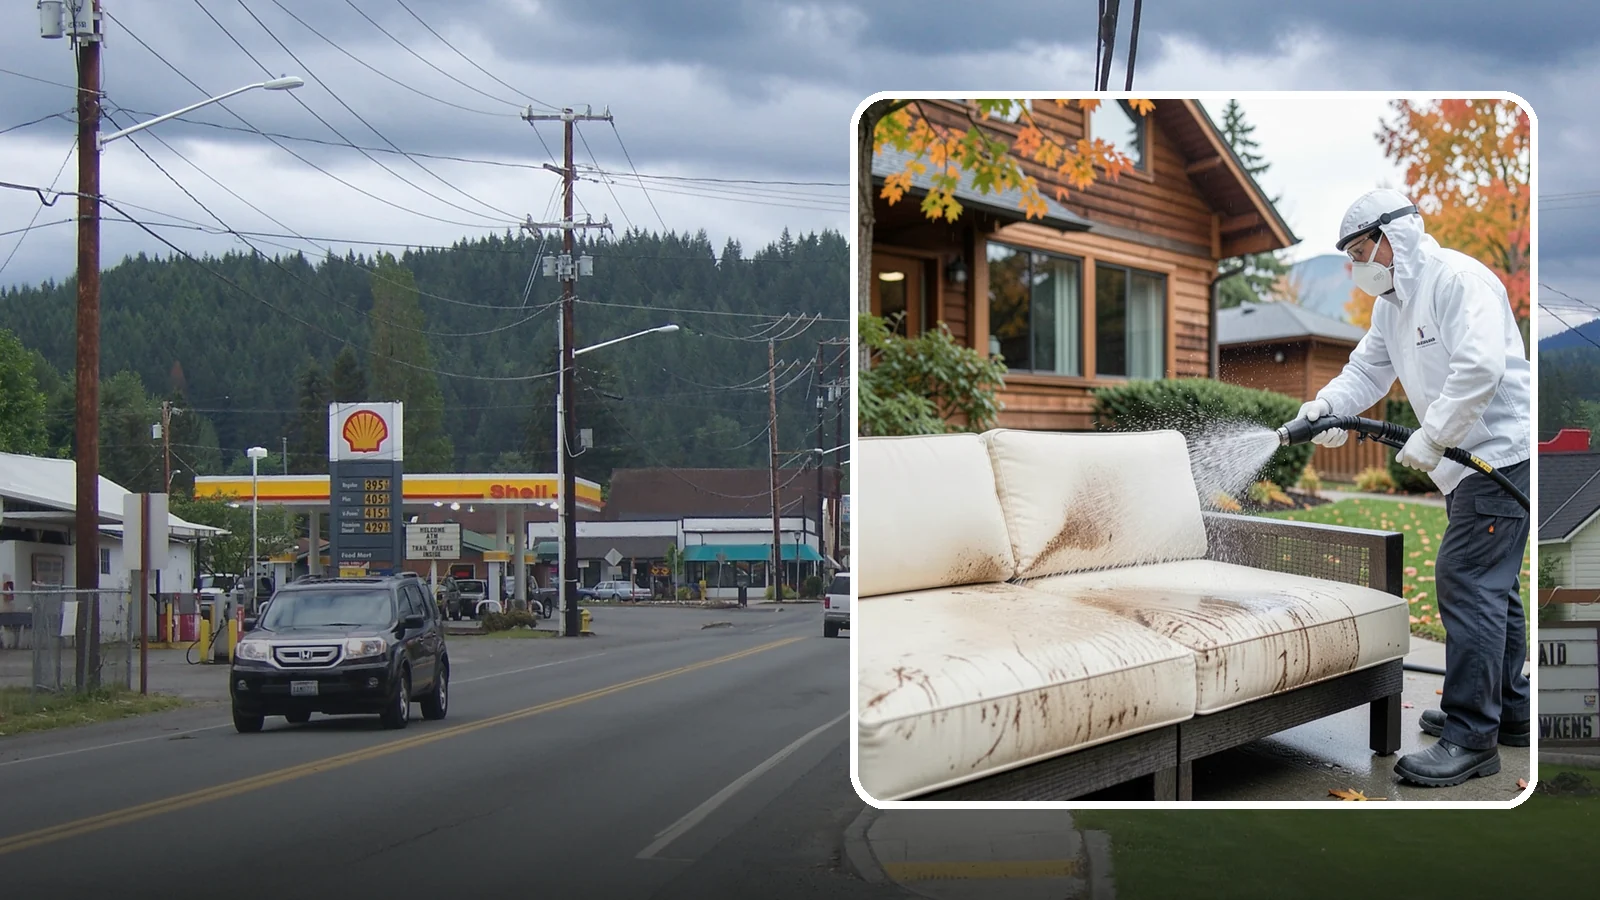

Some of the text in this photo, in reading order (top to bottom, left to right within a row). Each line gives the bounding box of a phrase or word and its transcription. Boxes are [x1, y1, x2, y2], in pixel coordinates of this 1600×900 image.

[366, 480, 384, 490] 395
[490, 484, 547, 499] Shell
[366, 494, 384, 504] 405
[366, 508, 383, 518] 415
[366, 522, 383, 532] 429
[1538, 643, 1567, 666] AID
